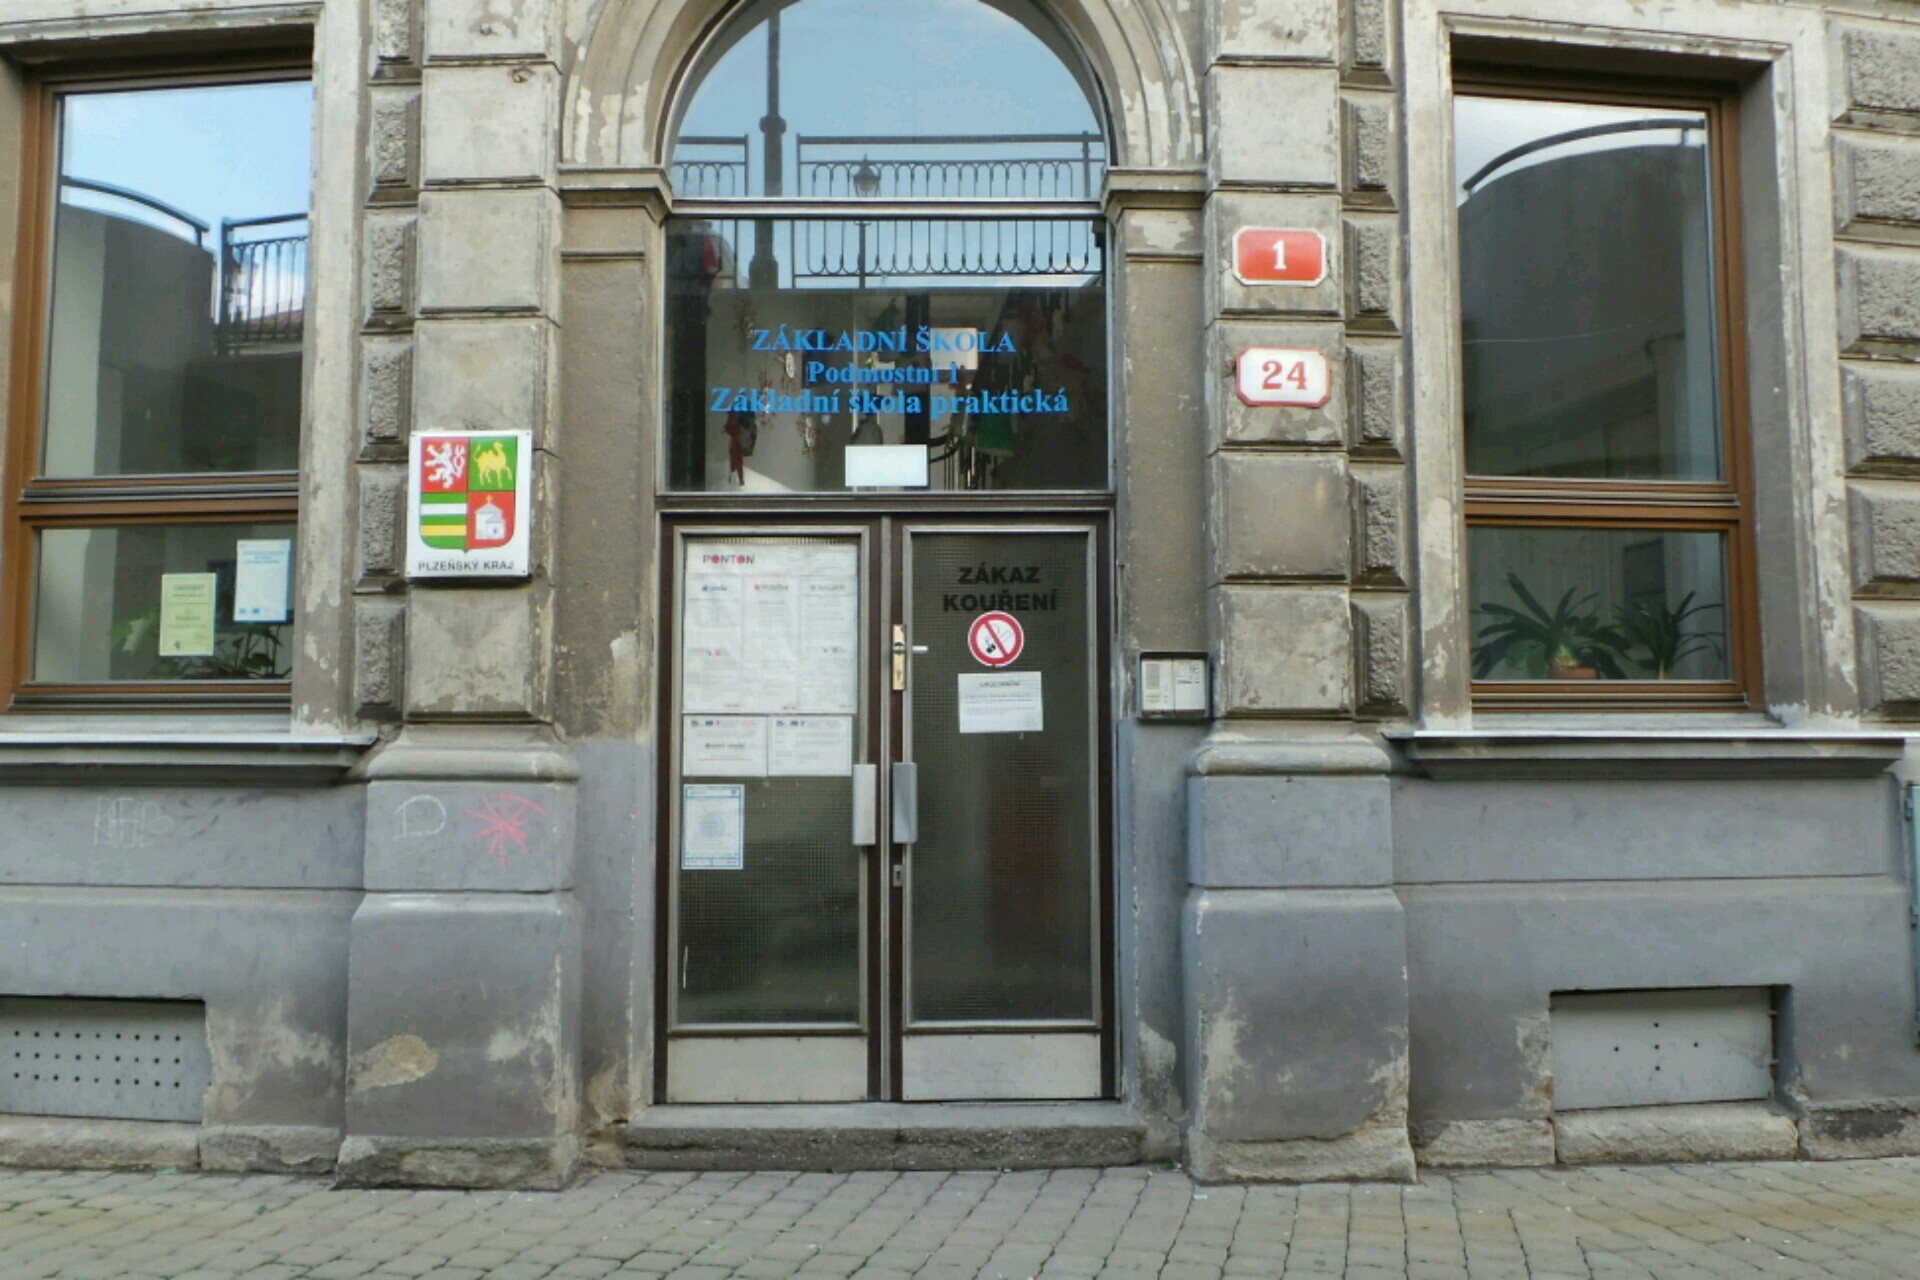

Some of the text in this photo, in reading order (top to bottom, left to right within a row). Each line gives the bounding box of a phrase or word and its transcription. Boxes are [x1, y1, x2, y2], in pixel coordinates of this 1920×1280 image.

[1272, 239, 1287, 271] 1
[752, 323, 1016, 353] ZÁKLADNÍ ŠKOLA
[949, 362, 959, 384] 1
[1261, 360, 1308, 390] 24
[710, 387, 1069, 420] Základní škola praktická
[418, 558, 514, 572] PLZEŇSKÝ KRAJ
[958, 563, 1041, 584] ZÁKAZ
[942, 588, 1058, 612] KOUŘENÍ
